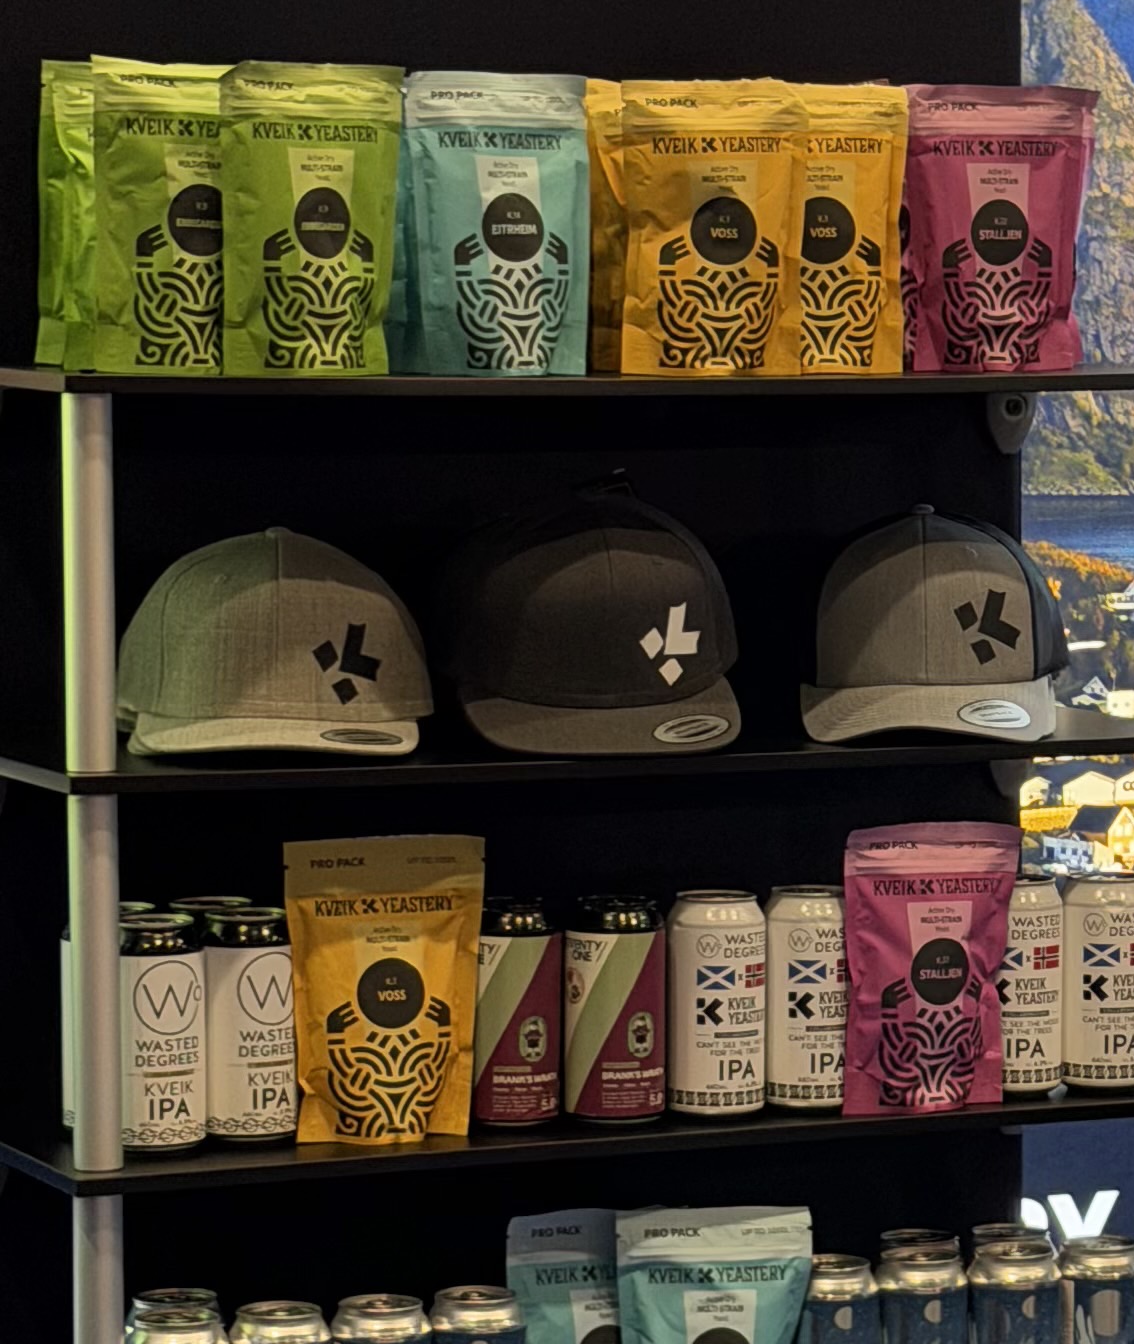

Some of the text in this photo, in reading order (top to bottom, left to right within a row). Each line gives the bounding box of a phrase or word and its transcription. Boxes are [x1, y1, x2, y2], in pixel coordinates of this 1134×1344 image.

[126, 117, 174, 136] KVEIK
[252, 122, 296, 140] KVEIK
[438, 131, 561, 151] KVEIK YEASTERY
[652, 136, 781, 154] KVEIK YEASTERY
[814, 137, 883, 153] YEASTERY
[932, 141, 1058, 156] KVEIK YEASTERY
[711, 227, 738, 238] VOSS
[810, 227, 838, 238] VOSS
[310, 857, 365, 869] PRO PACK
[873, 880, 916, 896] KVEIK
[315, 896, 453, 917] KVEIK YEASTERY
[1012, 914, 1060, 927] WASTED
[1012, 927, 1060, 940] DEGREES
[1015, 978, 1046, 990] KVEIK
[377, 989, 406, 1001] VOSS
[135, 1036, 199, 1052] WASTED
[1006, 1038, 1045, 1059] IPA
[135, 1052, 199, 1068] DEGREES
[810, 1053, 845, 1073] IPA
[719, 1059, 755, 1081] IPA
[145, 1080, 194, 1097] KVEIK
[252, 1088, 290, 1110] IPA
[149, 1097, 191, 1120] IPA
[531, 1228, 553, 1238] PRO
[644, 1228, 668, 1238] PRO
[671, 1227, 701, 1237] PACK
[535, 1267, 578, 1286] KVEIK
[648, 1264, 788, 1284] KVEIK YEASTERY
